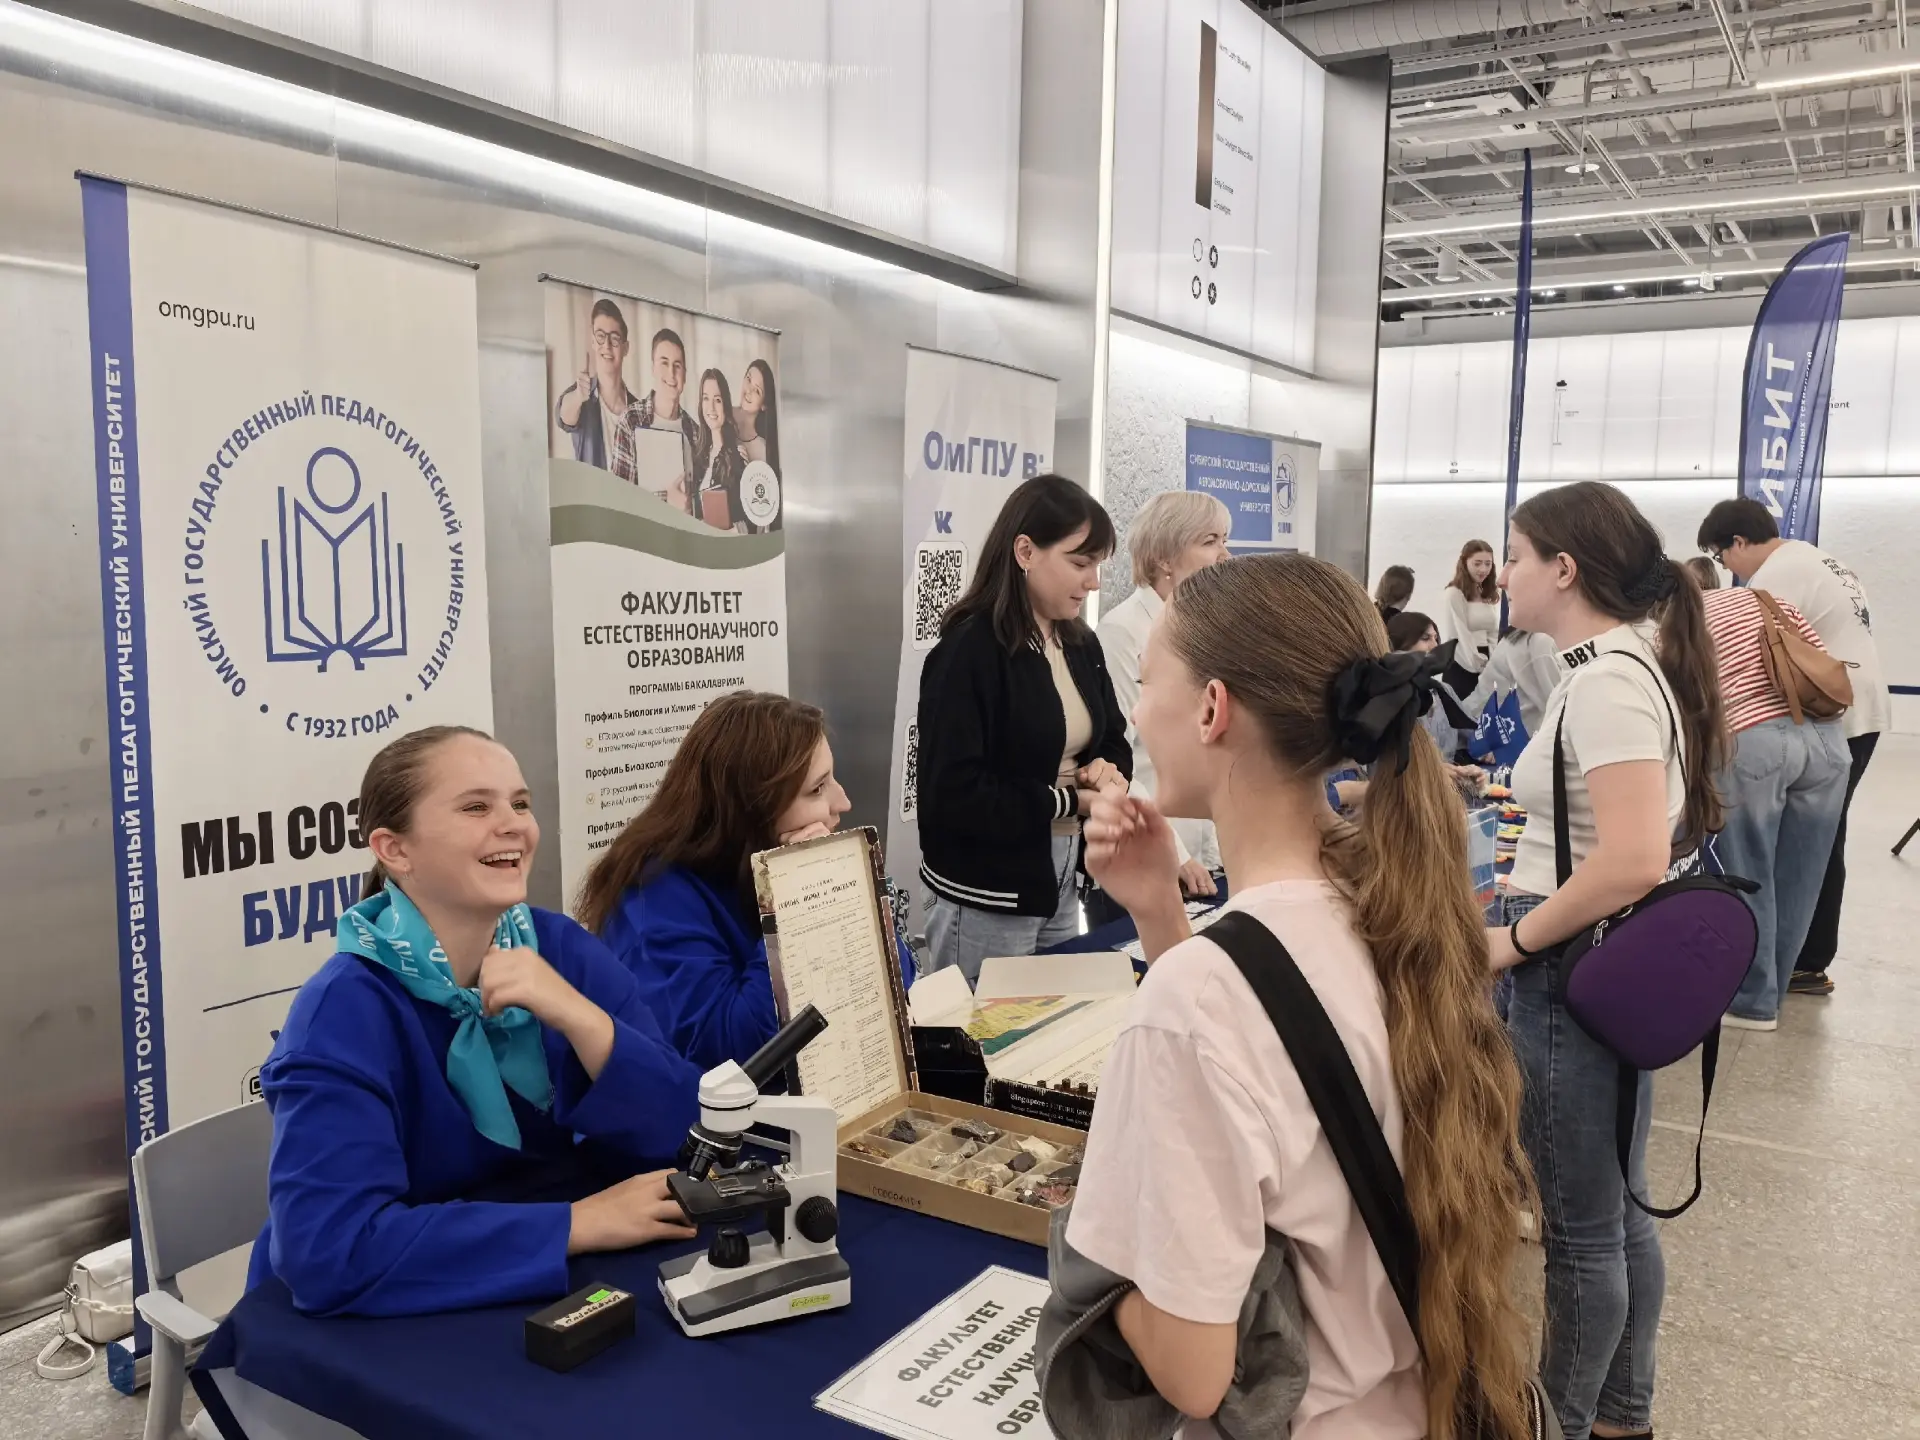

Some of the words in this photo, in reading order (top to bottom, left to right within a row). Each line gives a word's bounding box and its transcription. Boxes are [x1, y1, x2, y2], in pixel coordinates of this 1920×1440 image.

[158, 299, 256, 332] omgpu.ru
[105, 352, 129, 549] УНИВЕРСИТЕТ
[321, 394, 462, 535] ПЕДАГОГИЧЕСКИЙ
[924, 431, 1017, 477] ОмГПУ
[185, 390, 315, 584] ГОСУДАРСТВЕННЫЙ
[416, 540, 464, 691] УНИВЕРСИТЕТ
[583, 620, 779, 645] ЕСТЕСТВЕННОНАУЧНОГО
[620, 591, 743, 615] ФАКУЛЬТЕТ
[183, 592, 246, 697] ОМСКИЙ
[627, 645, 745, 668] ОБРАЗОВАНИЯ
[109, 556, 140, 802] ПЕДАГОГИЧЕСКИЙ
[629, 682, 683, 695] ПРОГРАММЫ
[685, 676, 745, 691] БАКАЛАВРИАТА
[286, 712, 299, 732] С
[303, 715, 346, 739] 1932
[351, 704, 399, 737] ГОДА
[584, 711, 622, 725] Профиль
[624, 706, 663, 719] Биология
[664, 706, 670, 714] и
[671, 703, 696, 714] Химия
[585, 766, 623, 780] Профиль
[181, 811, 275, 879] МЫ
[587, 820, 625, 835] Профиль
[120, 809, 153, 1071] ГОСУДАРСТВЕННЫЙ
[242, 871, 368, 947] БУДУ
[897, 1300, 1005, 1381] ФАКУЛЬТЕТ
[916, 1306, 1043, 1408] ЕСТЕСТВЕННО
